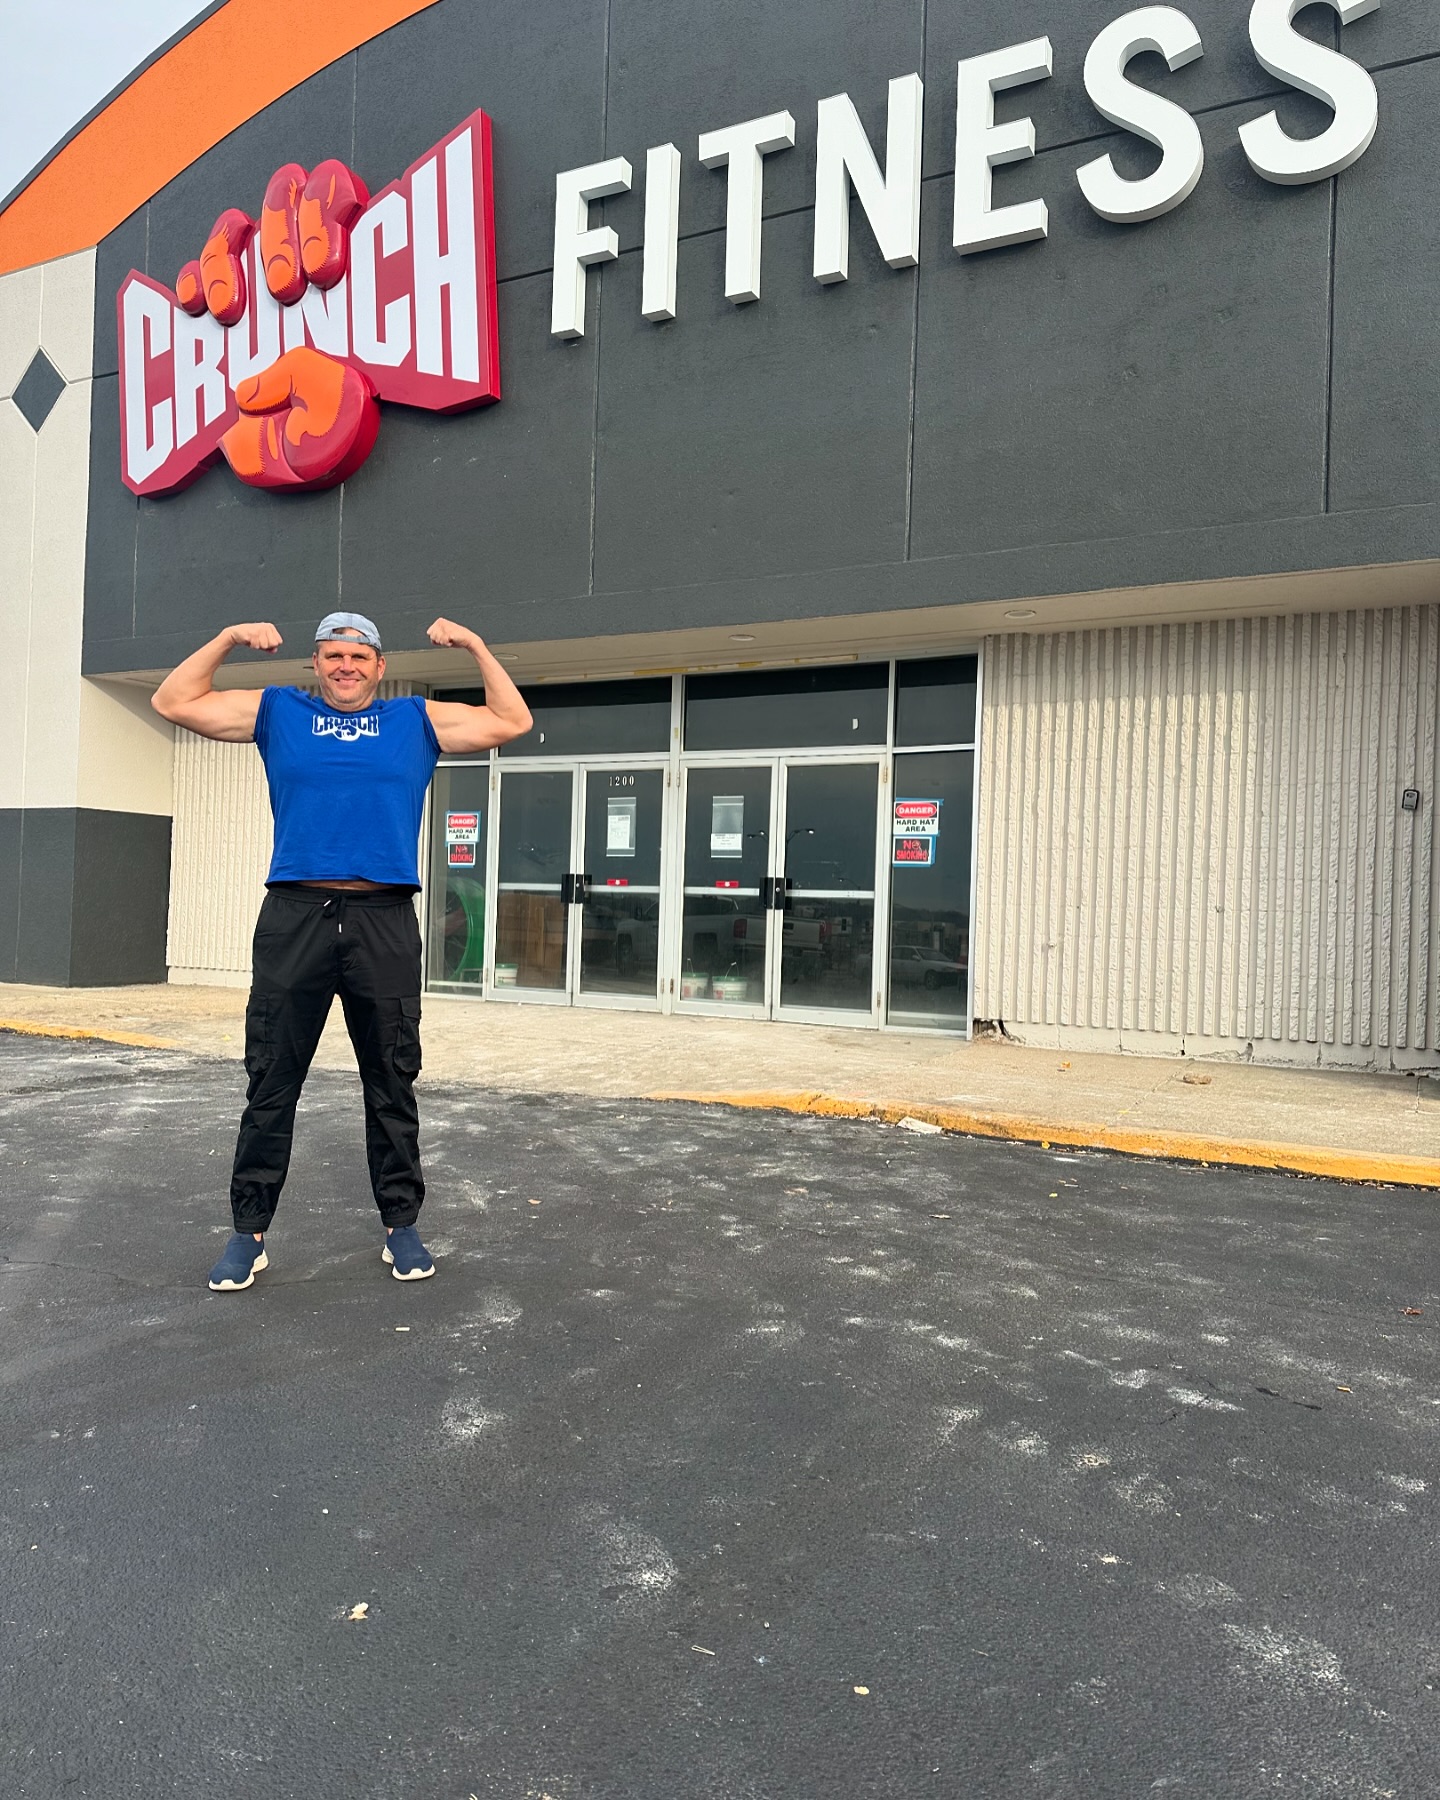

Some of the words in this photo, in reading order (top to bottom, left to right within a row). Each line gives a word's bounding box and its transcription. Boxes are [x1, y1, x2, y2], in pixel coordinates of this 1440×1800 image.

[551, 0, 1380, 339] FITNESS
[123, 126, 480, 485] CRUNCH
[312, 714, 379, 736] CRUNCH
[609, 775, 635, 787] 1200
[898, 806, 934, 814] DANGER
[905, 825, 926, 833] AREA
[455, 844, 468, 854] NO
[903, 839, 921, 850] NO
[450, 853, 473, 862] SMOKING
[896, 849, 929, 862] SMOKING
